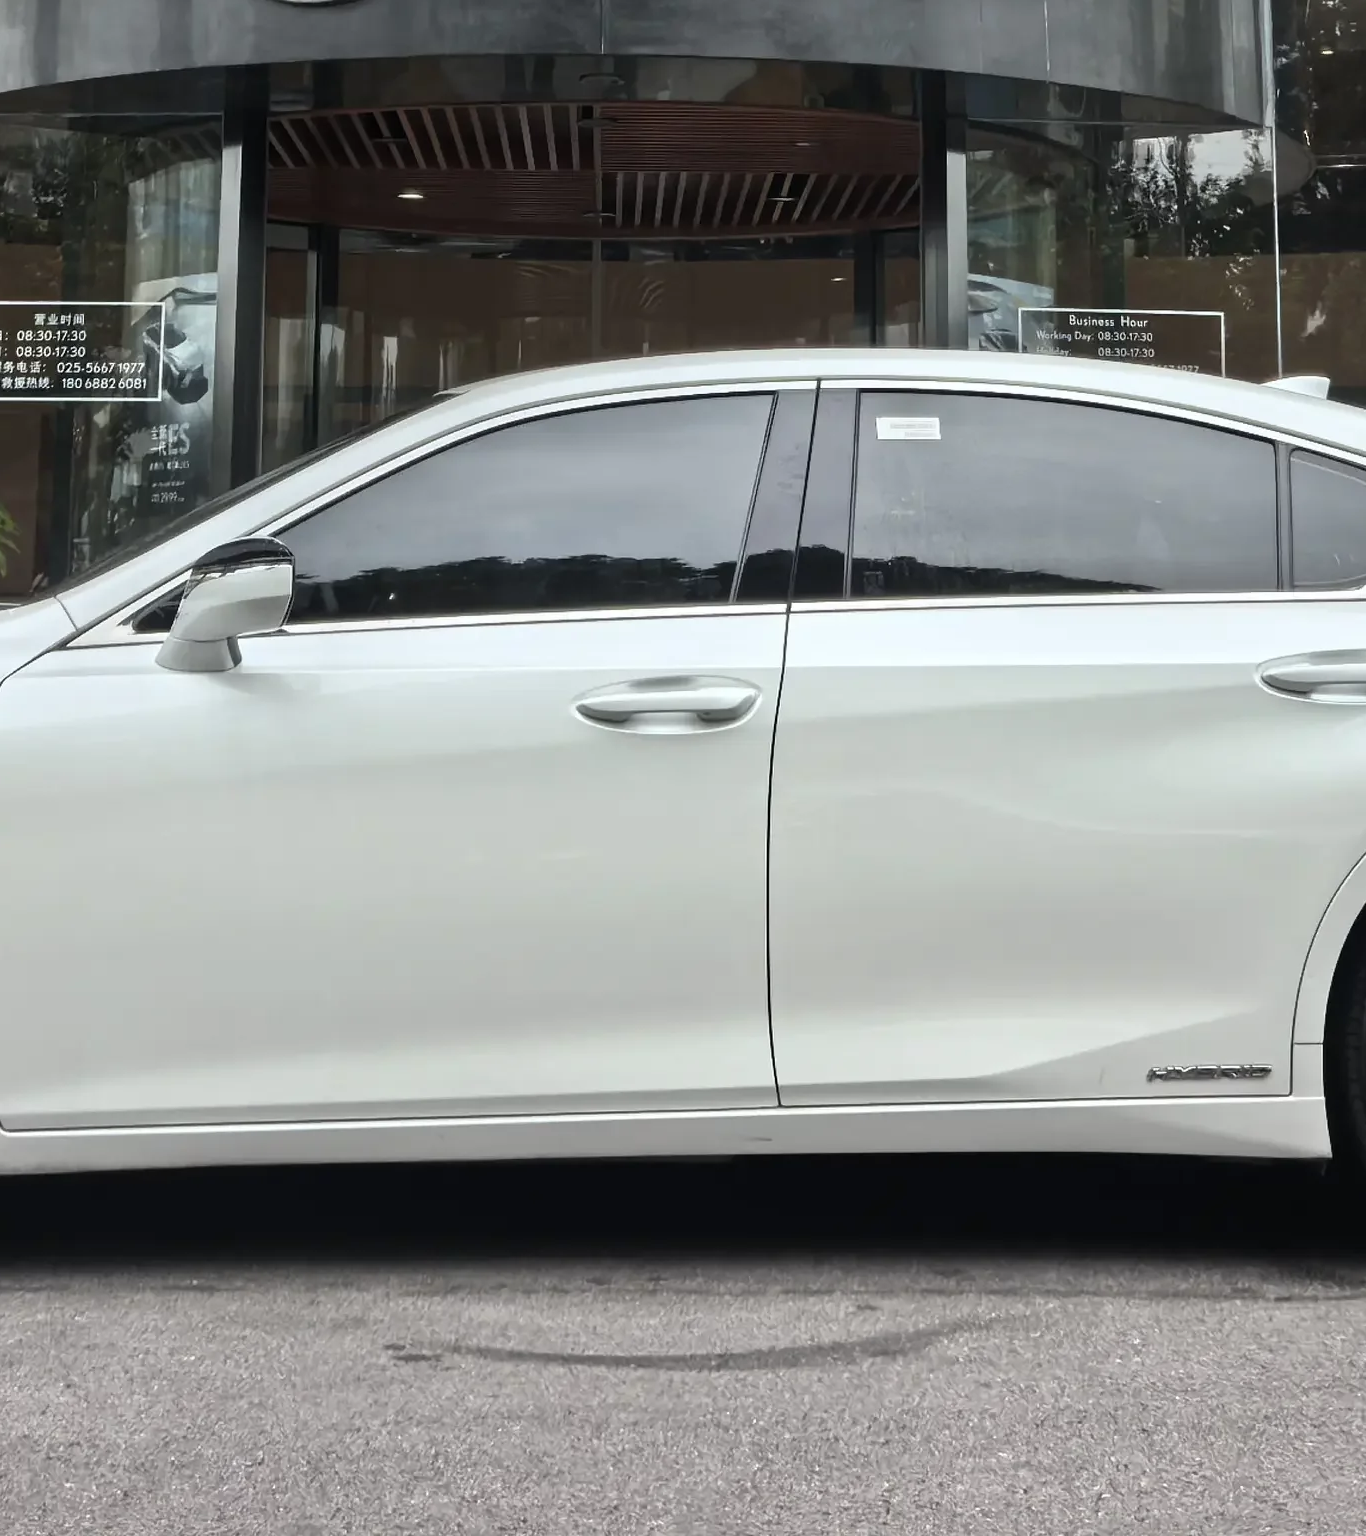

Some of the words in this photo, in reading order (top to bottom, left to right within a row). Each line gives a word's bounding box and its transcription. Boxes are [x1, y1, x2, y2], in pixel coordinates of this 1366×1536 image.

[34, 313, 85, 326] 营业时间
[1069, 314, 1115, 327] Business
[1120, 315, 1149, 328] Hour
[16, 330, 87, 341] 08:30-17:30
[1036, 330, 1072, 342] Working
[1097, 331, 1153, 342] 08:30-17:30
[16, 346, 86, 358] 08:30-17:30
[1097, 347, 1156, 358] 08:30-17:30
